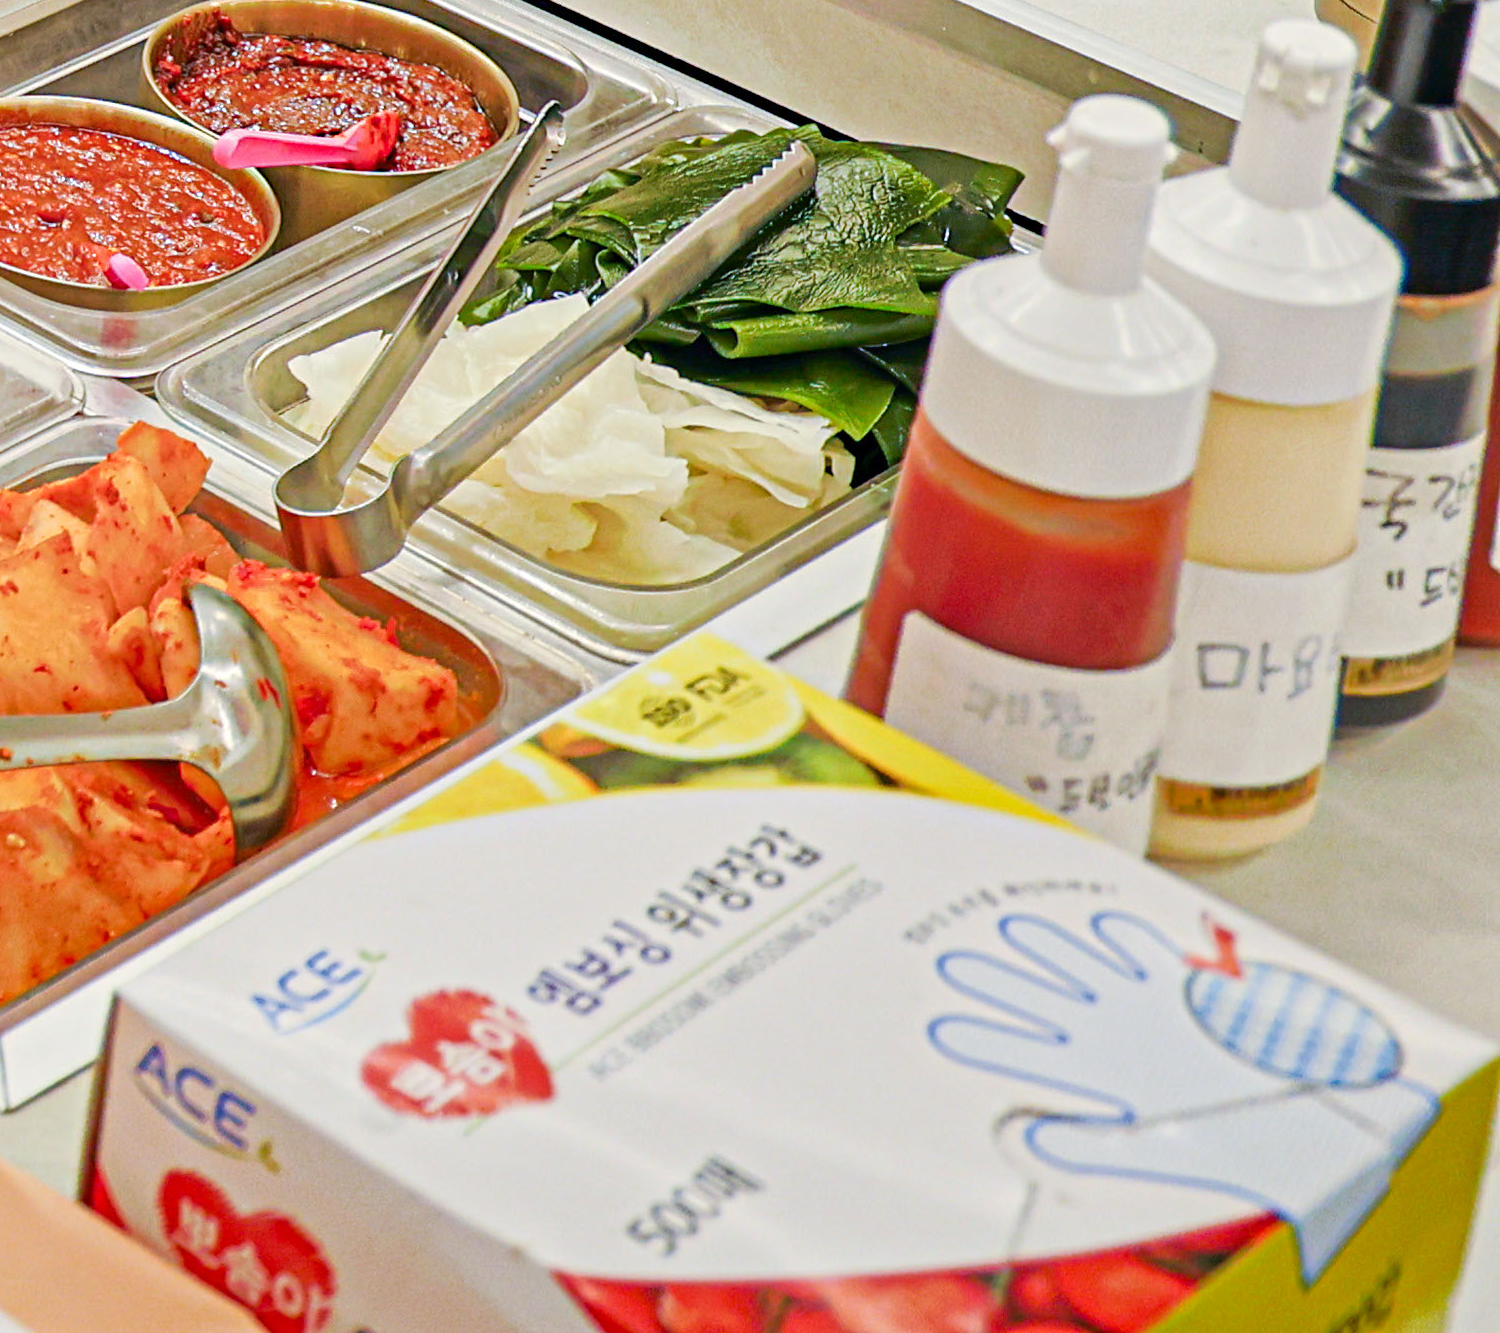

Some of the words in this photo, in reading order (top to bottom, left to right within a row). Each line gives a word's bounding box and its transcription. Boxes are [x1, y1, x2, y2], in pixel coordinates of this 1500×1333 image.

[526, 919, 673, 1018] 엠보싱
[646, 823, 823, 941] 위생장갑
[250, 949, 362, 1025] ACE
[136, 1044, 257, 1150] ACE
